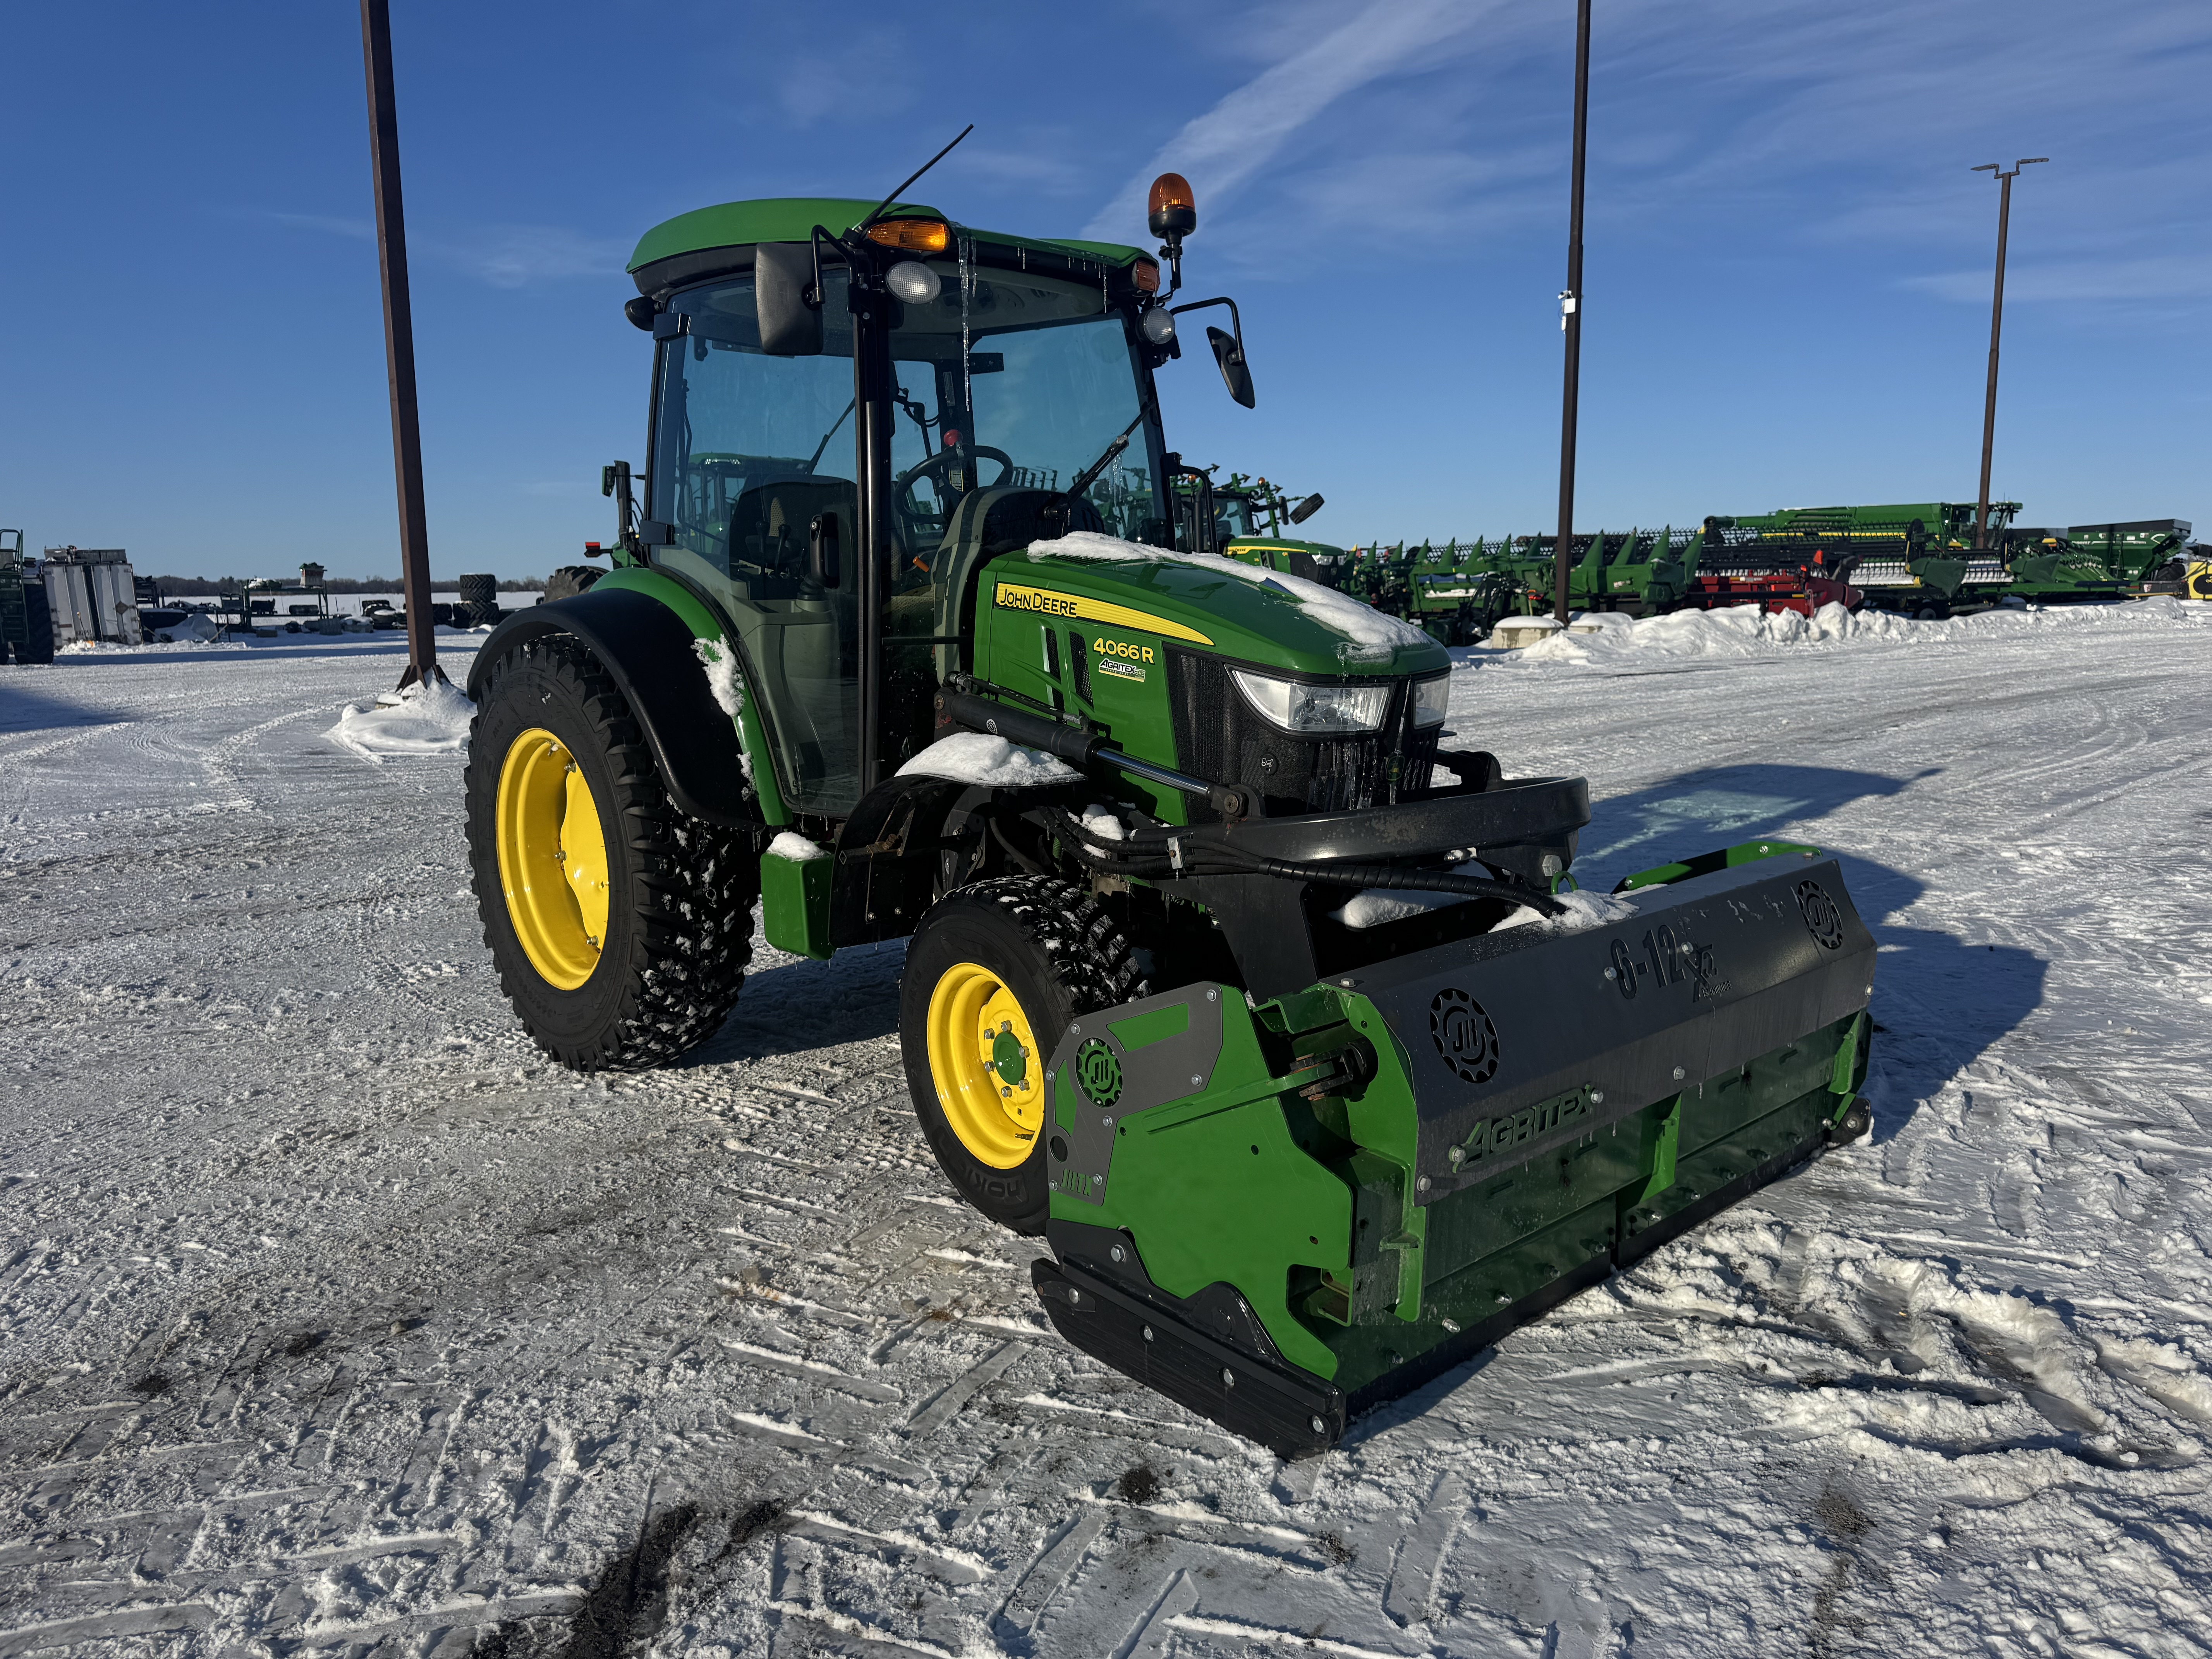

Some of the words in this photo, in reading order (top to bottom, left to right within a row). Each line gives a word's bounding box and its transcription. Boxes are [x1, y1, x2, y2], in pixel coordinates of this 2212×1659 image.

[1000, 588, 1031, 608] JOHN
[1033, 592, 1077, 616] DEERE
[1101, 659, 1135, 674] AGRITEX
[1610, 924, 1687, 1000] 6-12
[1452, 1017, 1479, 1053] JR
[1090, 1058, 1109, 1085] JR
[1452, 1084, 1593, 1174] AGRITEX
